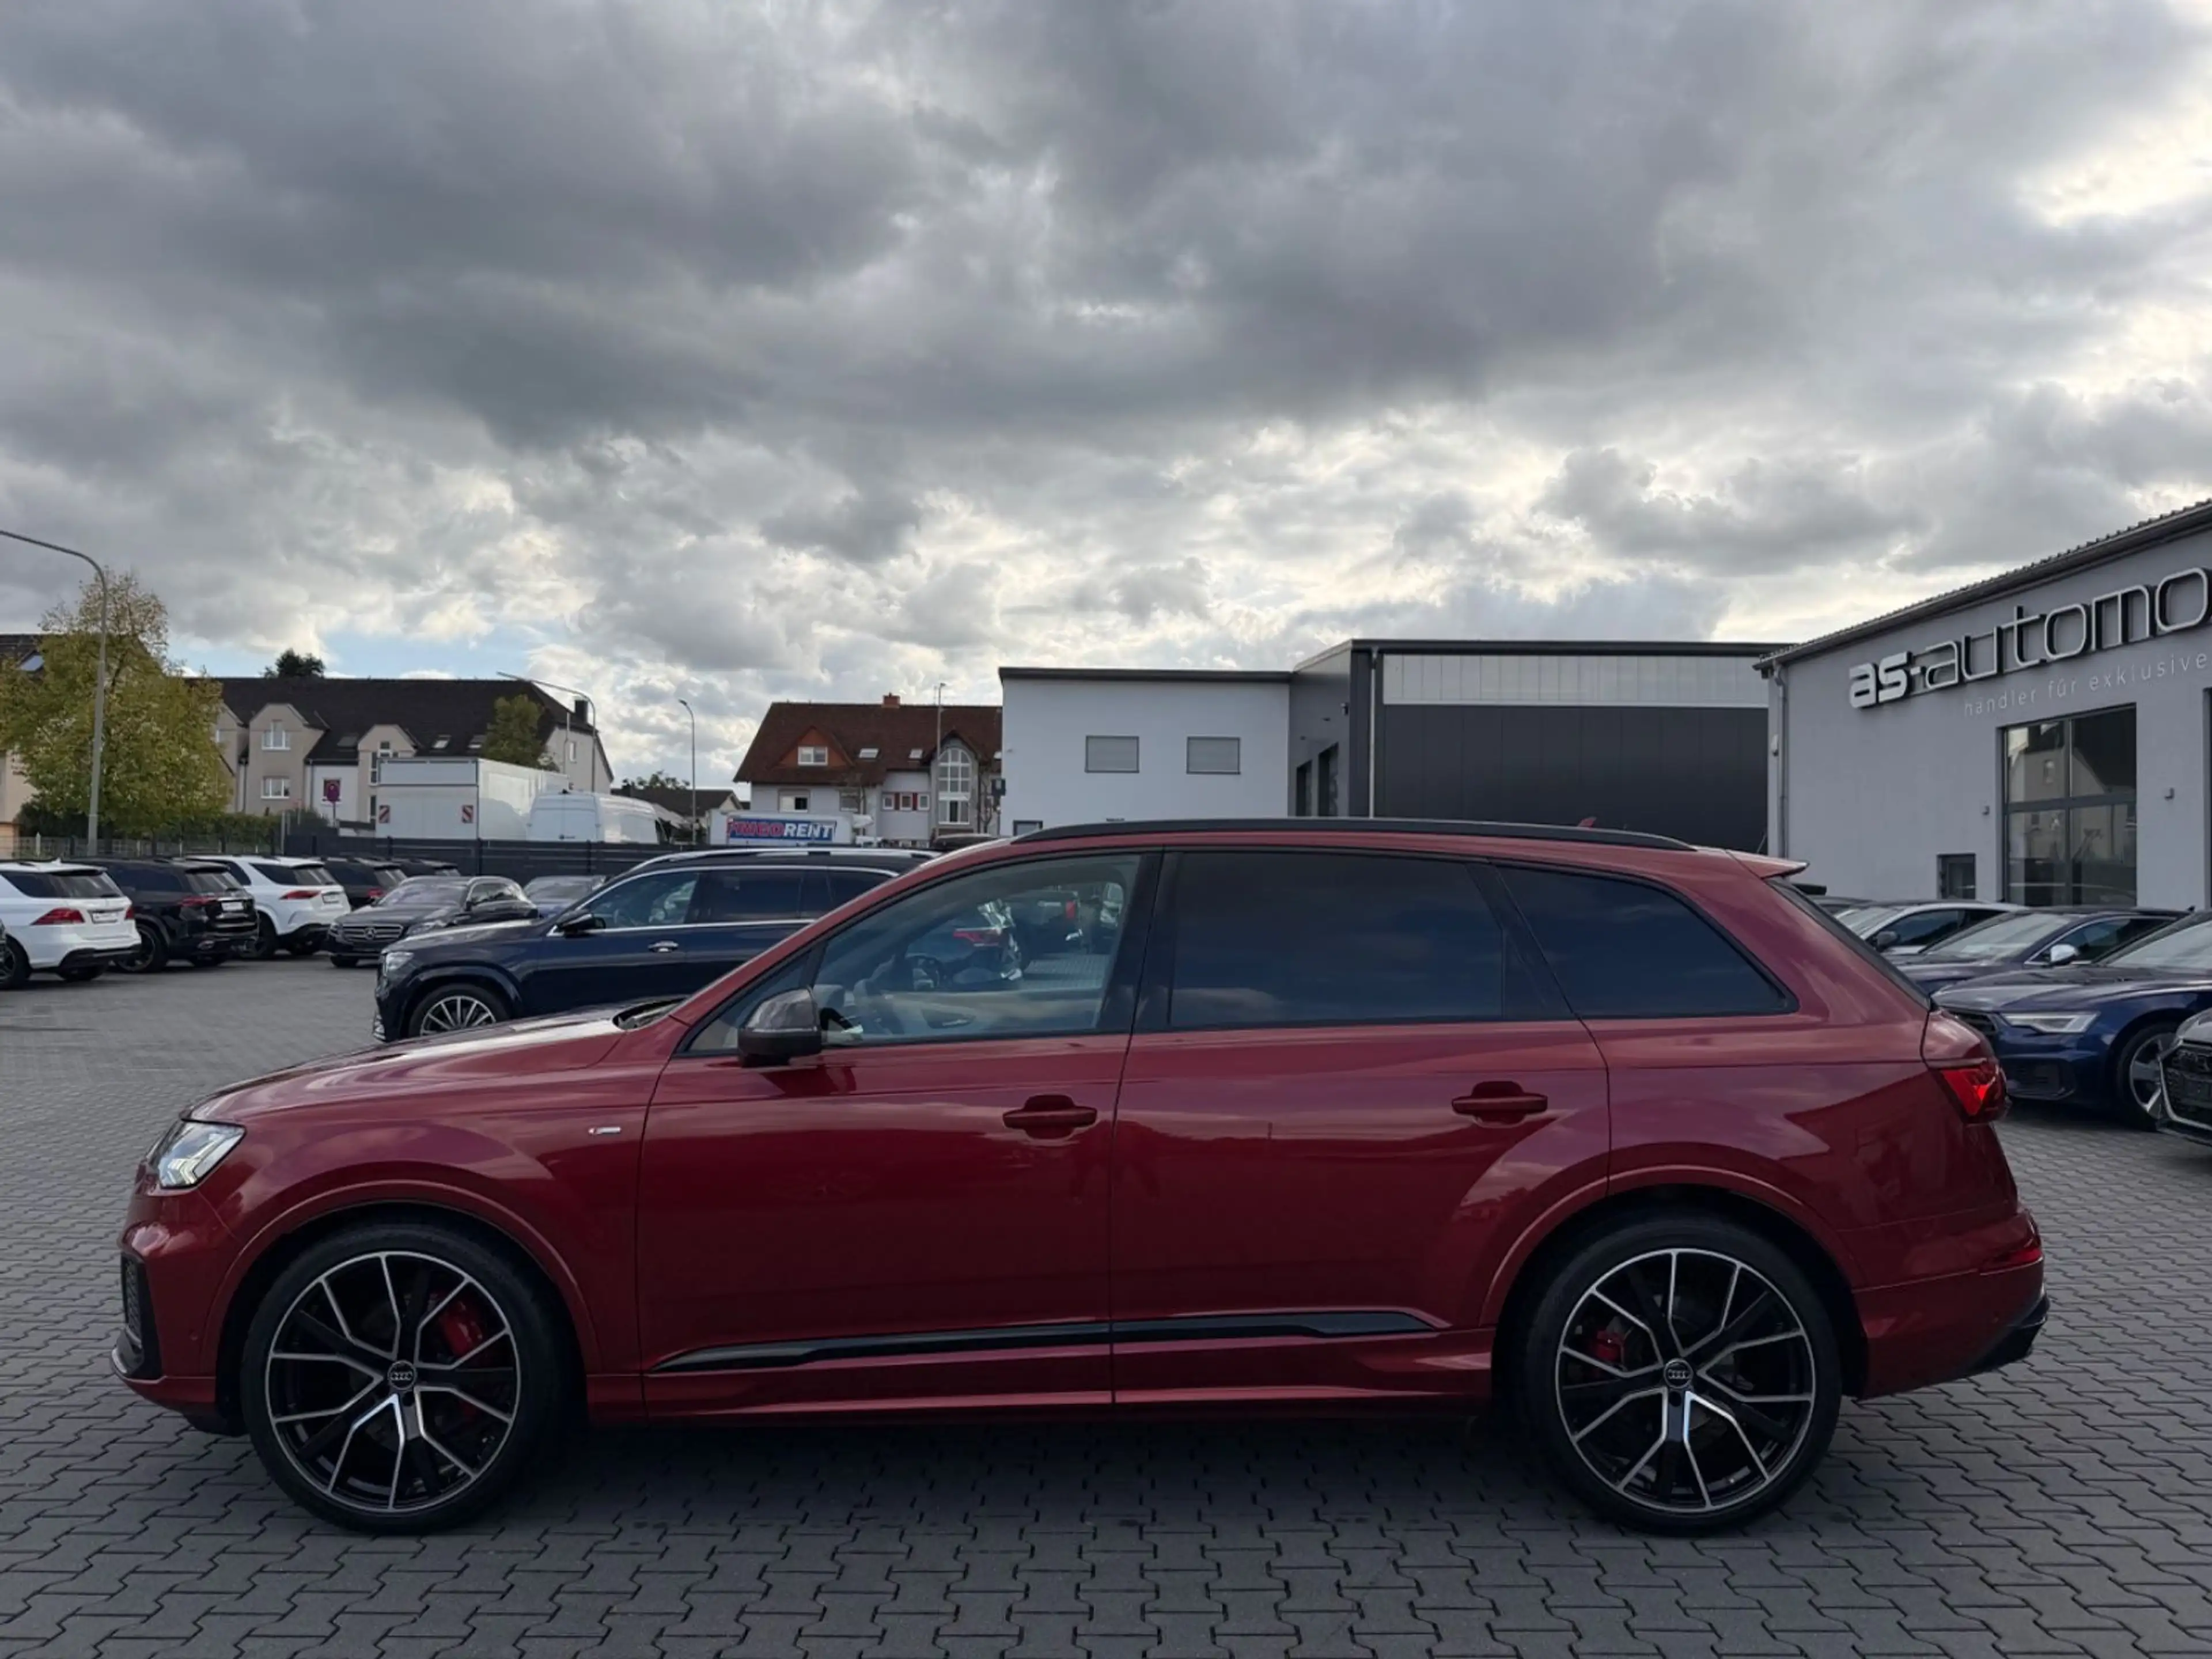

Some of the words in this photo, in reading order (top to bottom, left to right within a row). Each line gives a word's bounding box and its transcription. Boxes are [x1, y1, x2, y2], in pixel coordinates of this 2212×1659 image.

[1964, 688, 2036, 716] händler
[2048, 677, 2077, 699] für
[2089, 653, 2207, 691] exklusive
